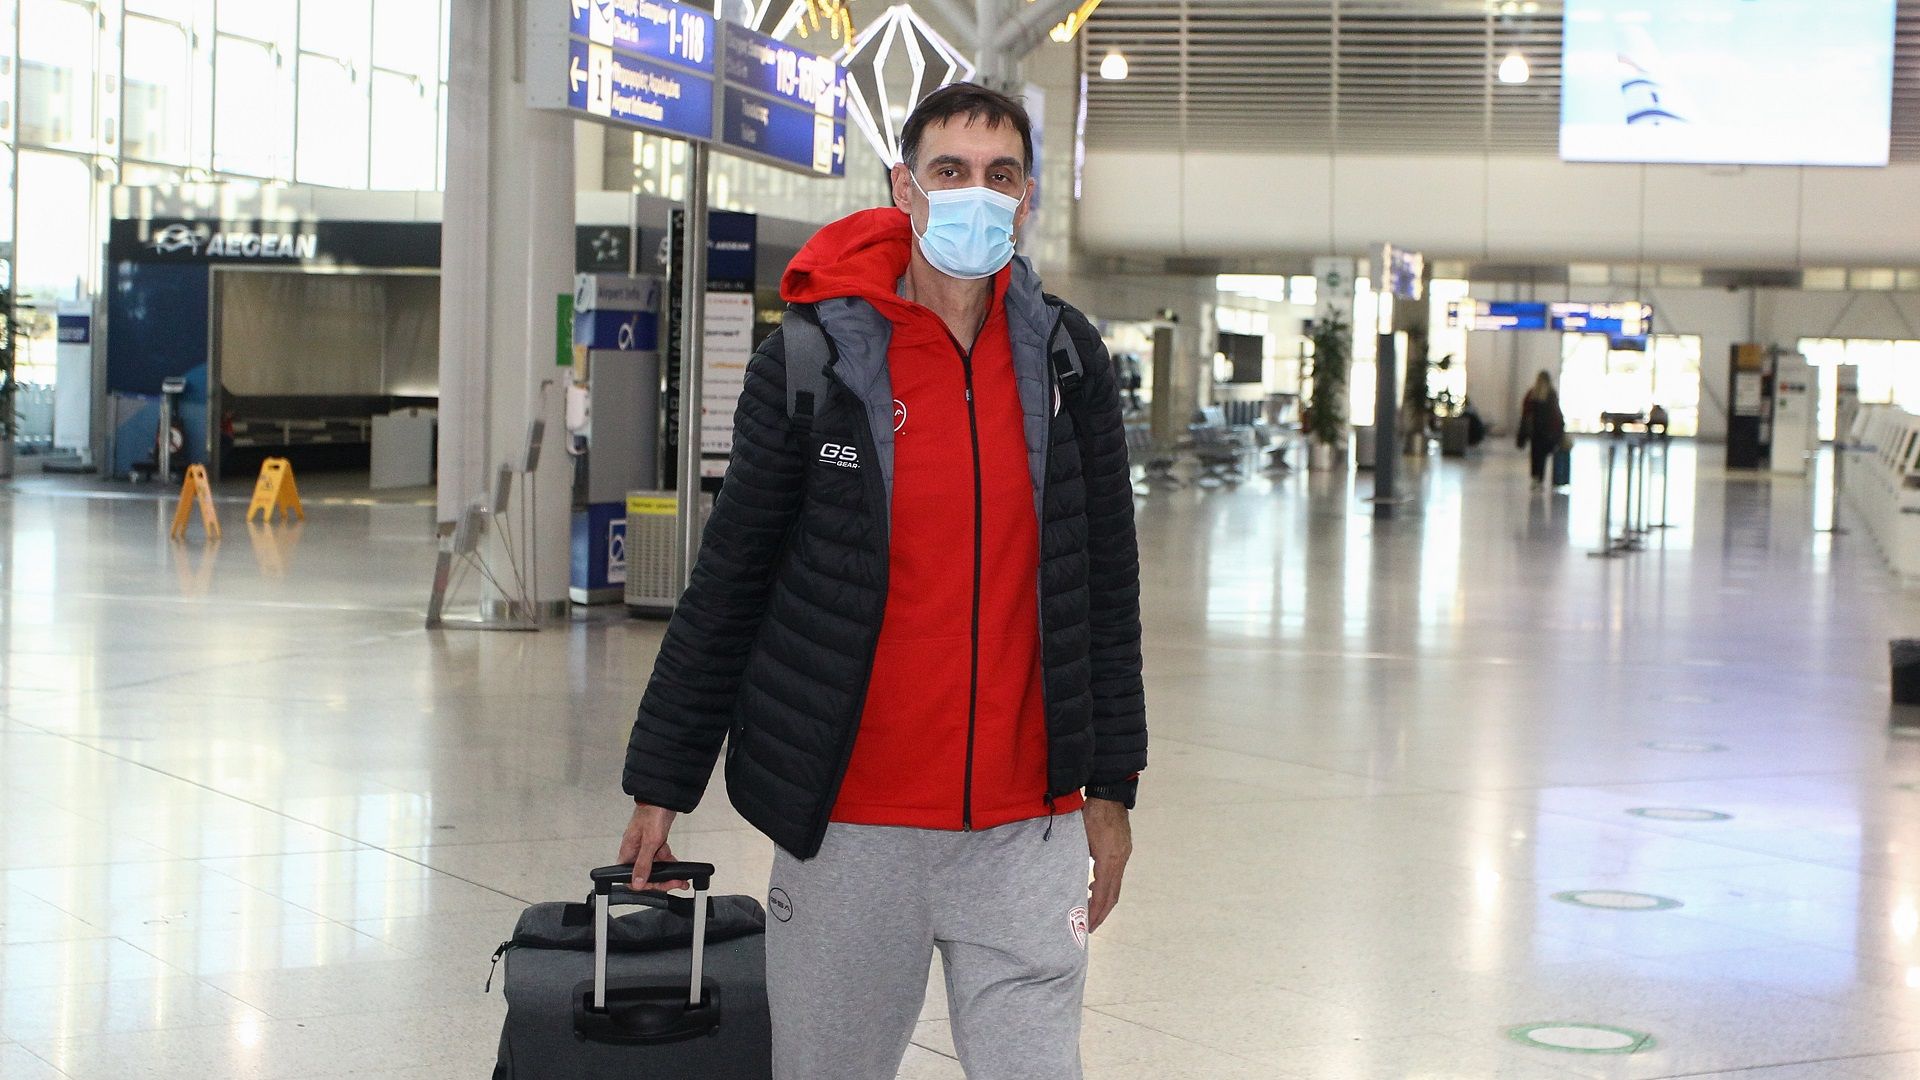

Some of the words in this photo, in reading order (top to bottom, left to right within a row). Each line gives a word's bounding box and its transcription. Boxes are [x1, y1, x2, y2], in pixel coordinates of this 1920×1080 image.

[669, 8, 705, 63] 1-118
[205, 232, 318, 259] AEGEAN
[820, 443, 857, 461] GS
